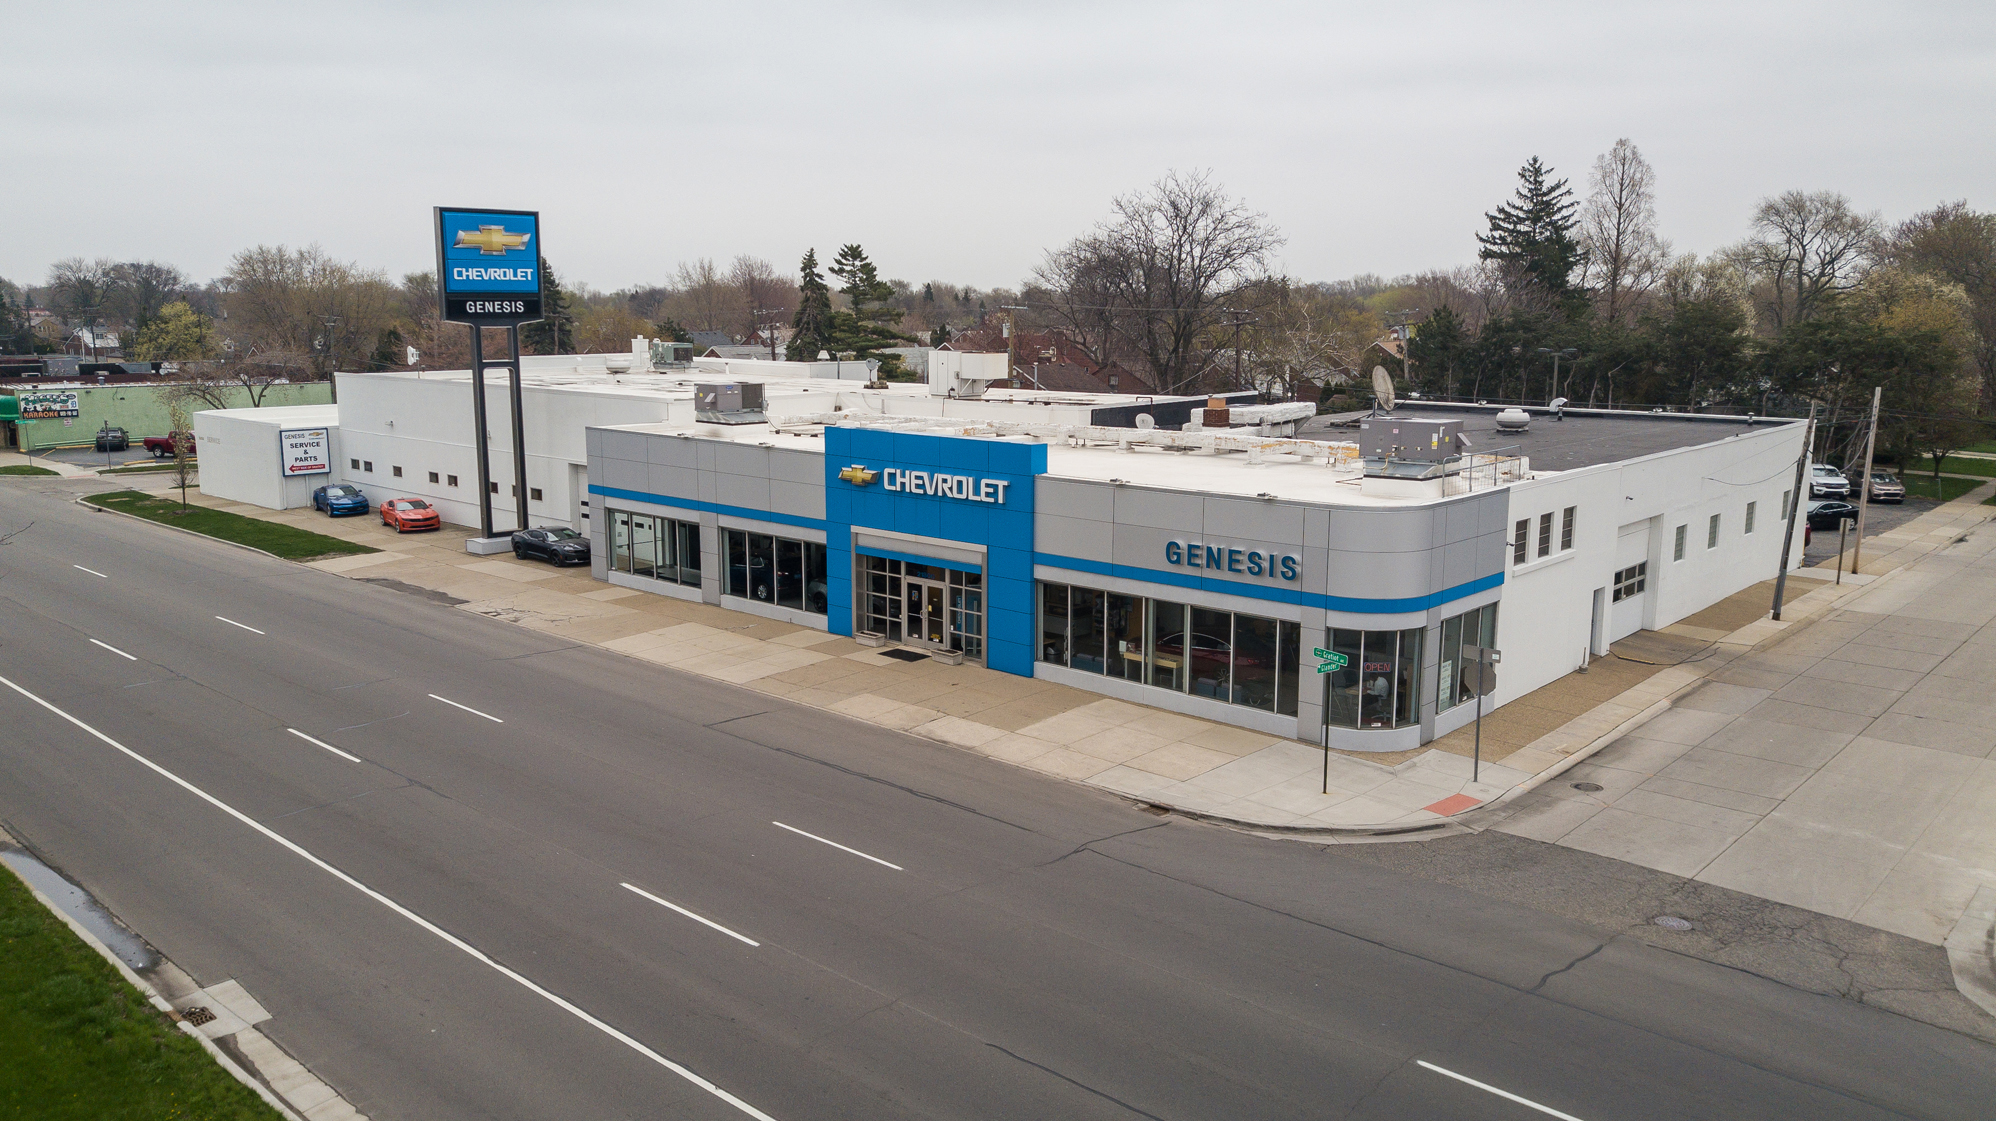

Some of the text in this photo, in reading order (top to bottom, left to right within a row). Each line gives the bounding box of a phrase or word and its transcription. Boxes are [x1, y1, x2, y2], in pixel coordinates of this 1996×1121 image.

[453, 267, 534, 281] CHEVROLET
[466, 301, 525, 313] GENESIS
[289, 441, 321, 449] SERVICE
[294, 455, 318, 463] PARTS
[883, 468, 1010, 504] CHEVROLET
[1165, 540, 1301, 581] GENESIS
[1323, 651, 1339, 661] Gratiot
[1364, 663, 1391, 671] OPEN
